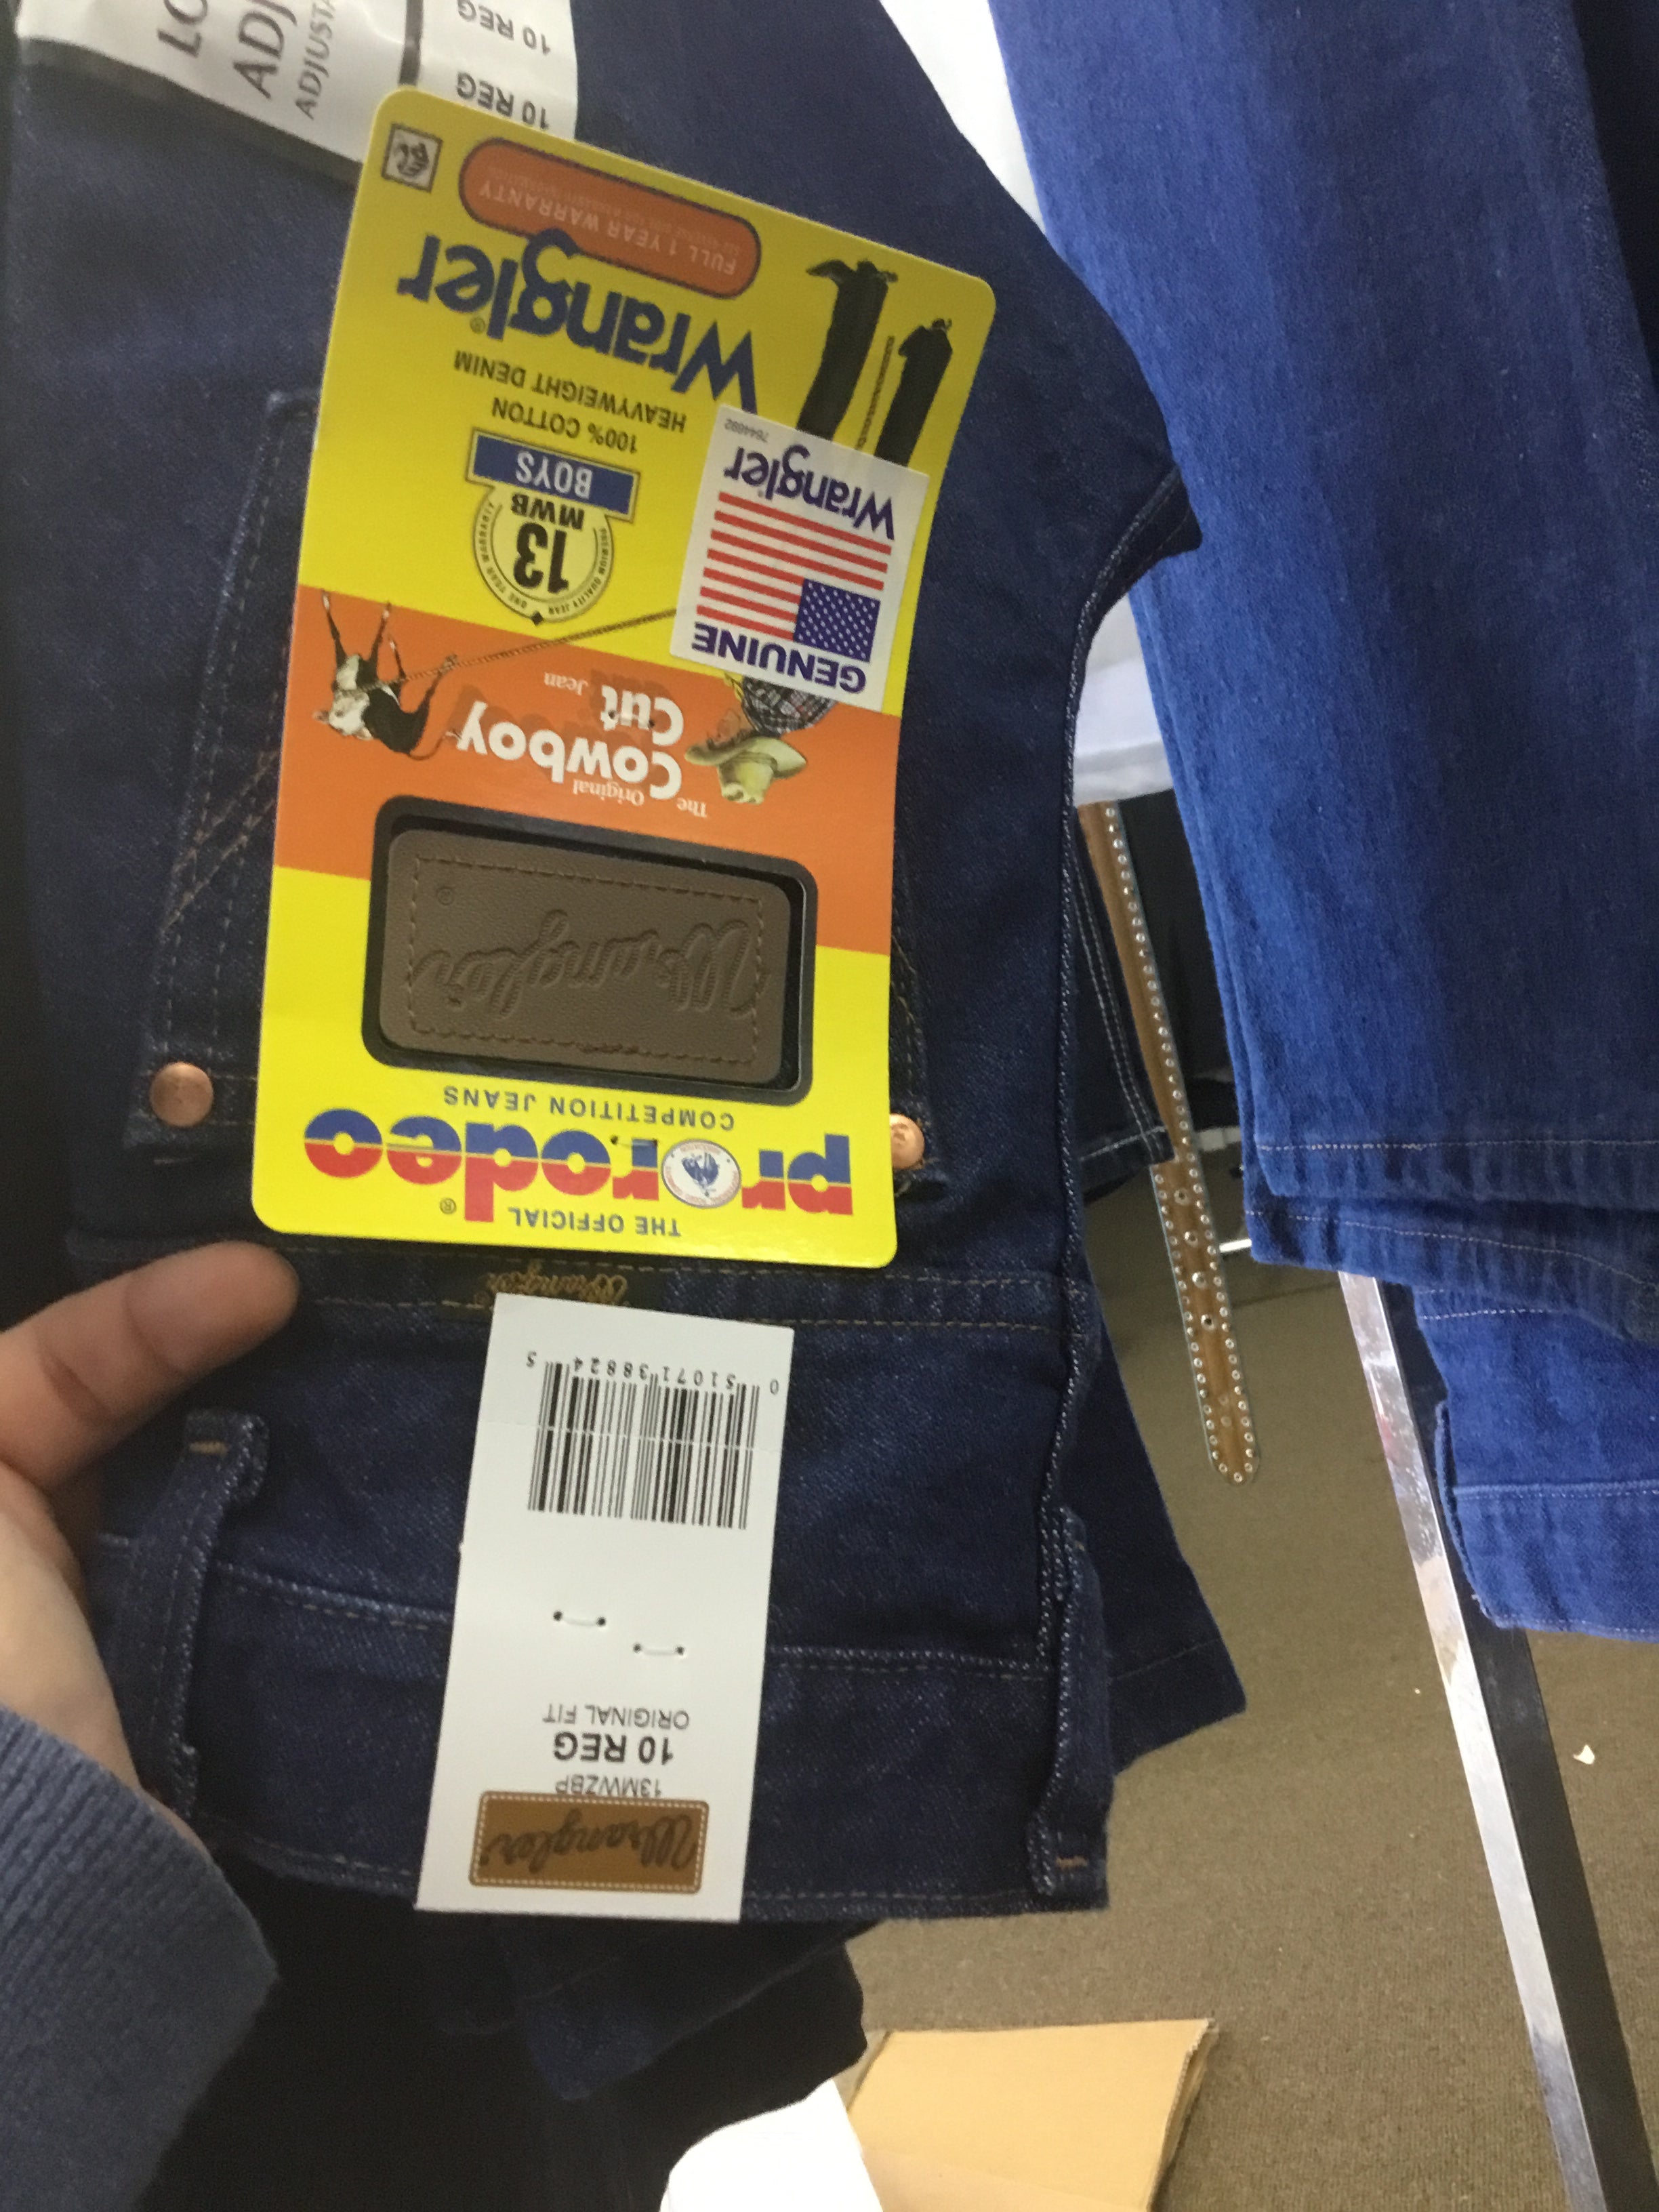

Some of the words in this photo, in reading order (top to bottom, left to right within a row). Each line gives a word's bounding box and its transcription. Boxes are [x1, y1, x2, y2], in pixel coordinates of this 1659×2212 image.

[456, 0, 515, 41] REG
[522, 26, 551, 56] 10
[456, 71, 515, 118] REG
[521, 99, 550, 130] 10
[478, 180, 600, 233] WARRANTY
[607, 222, 661, 253] YEAR
[668, 237, 678, 256] 1
[688, 245, 738, 276] FULL
[396, 228, 758, 415] Wrangler
[453, 349, 527, 388] DENIM
[491, 396, 581, 440] COTTON
[531, 372, 687, 434] HEAVYWEIGHT
[588, 422, 638, 454] 100%
[514, 450, 593, 500] BOYS
[722, 443, 895, 541] Wrangler
[510, 491, 585, 531] MWB
[512, 522, 570, 594] 13
[691, 621, 867, 695] GENUINE
[544, 671, 589, 696] Jean
[600, 684, 684, 746] Cut
[455, 699, 683, 800] Cowboy
[572, 777, 646, 808] Original
[676, 796, 708, 819] The
[409, 908, 773, 1019] Wrangler
[443, 1084, 537, 1112] JEANS
[548, 1093, 735, 1131] COMPETITION
[506, 1206, 626, 1235] OFFICIAL
[635, 1215, 682, 1239] THE
[525, 1350, 537, 1368] 5
[769, 1378, 780, 1396] 0
[542, 1703, 578, 1725] FIT
[583, 1704, 691, 1730] ORIGINAL
[552, 1730, 628, 1763] REG
[637, 1735, 674, 1766] 10
[554, 1774, 662, 1799] 13MWZBP
[478, 1807, 698, 1875] Wrangler
